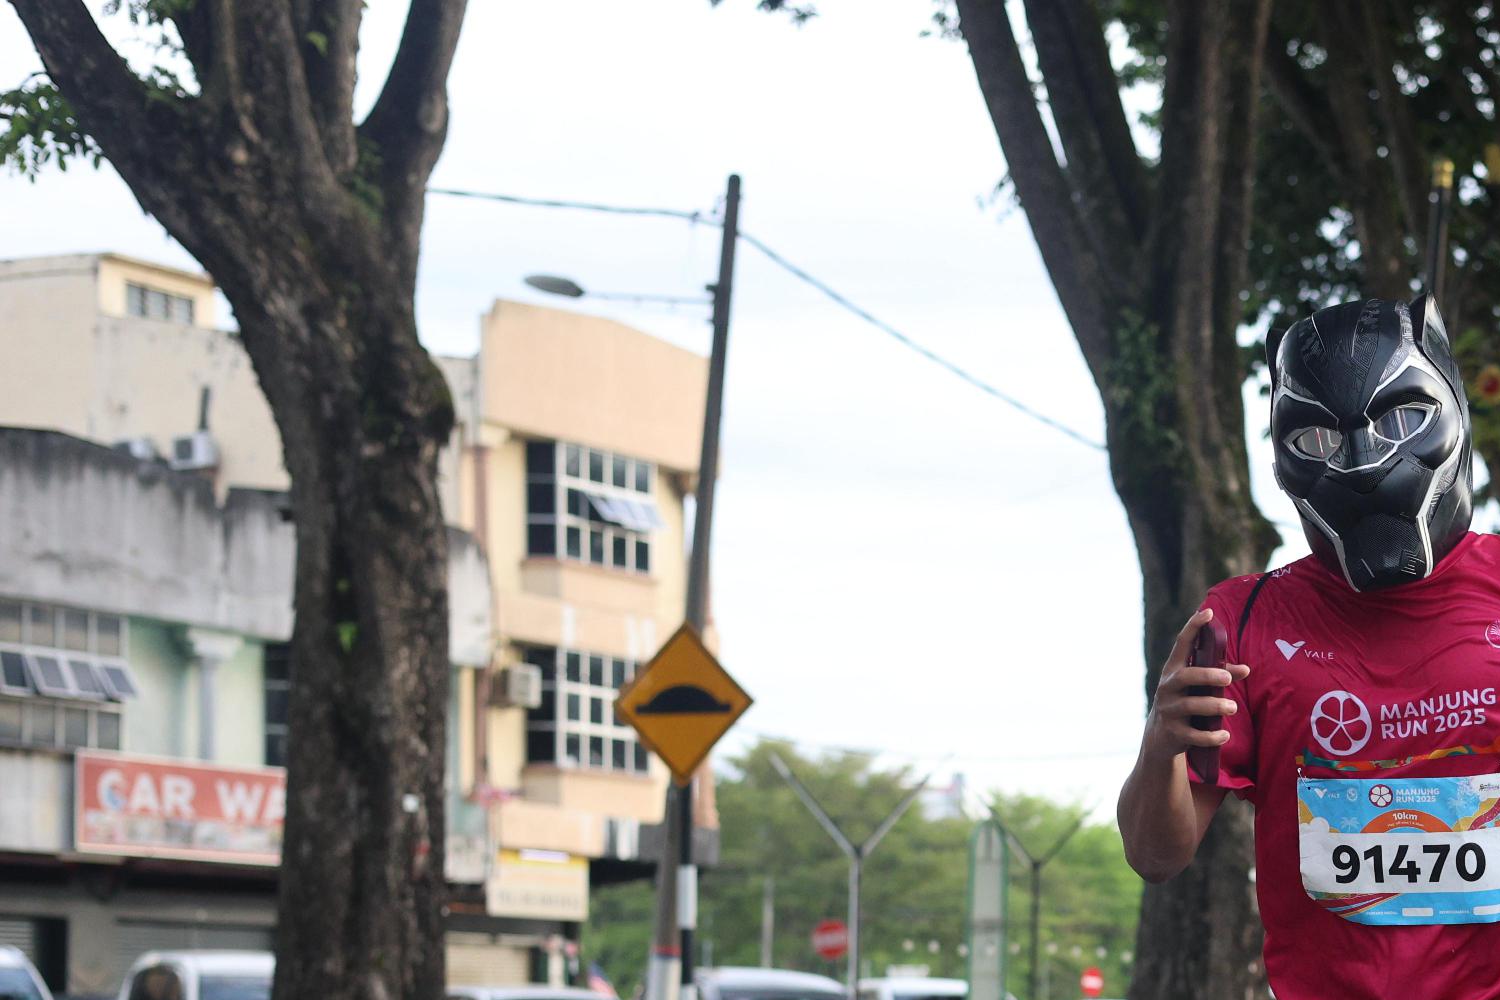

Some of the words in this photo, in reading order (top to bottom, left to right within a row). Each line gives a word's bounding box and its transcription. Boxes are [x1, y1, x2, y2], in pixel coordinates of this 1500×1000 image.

[1304, 649, 1334, 660] VALE
[1380, 687, 1497, 721] MANJUNG
[1380, 718, 1428, 739] RUN
[1433, 708, 1487, 733] 2025
[96, 768, 196, 818] CAR
[1395, 787, 1440, 796] MANJUNG
[1416, 795, 1437, 803] 2025
[1392, 812, 1418, 820] 10km
[1332, 842, 1487, 884] 91470
